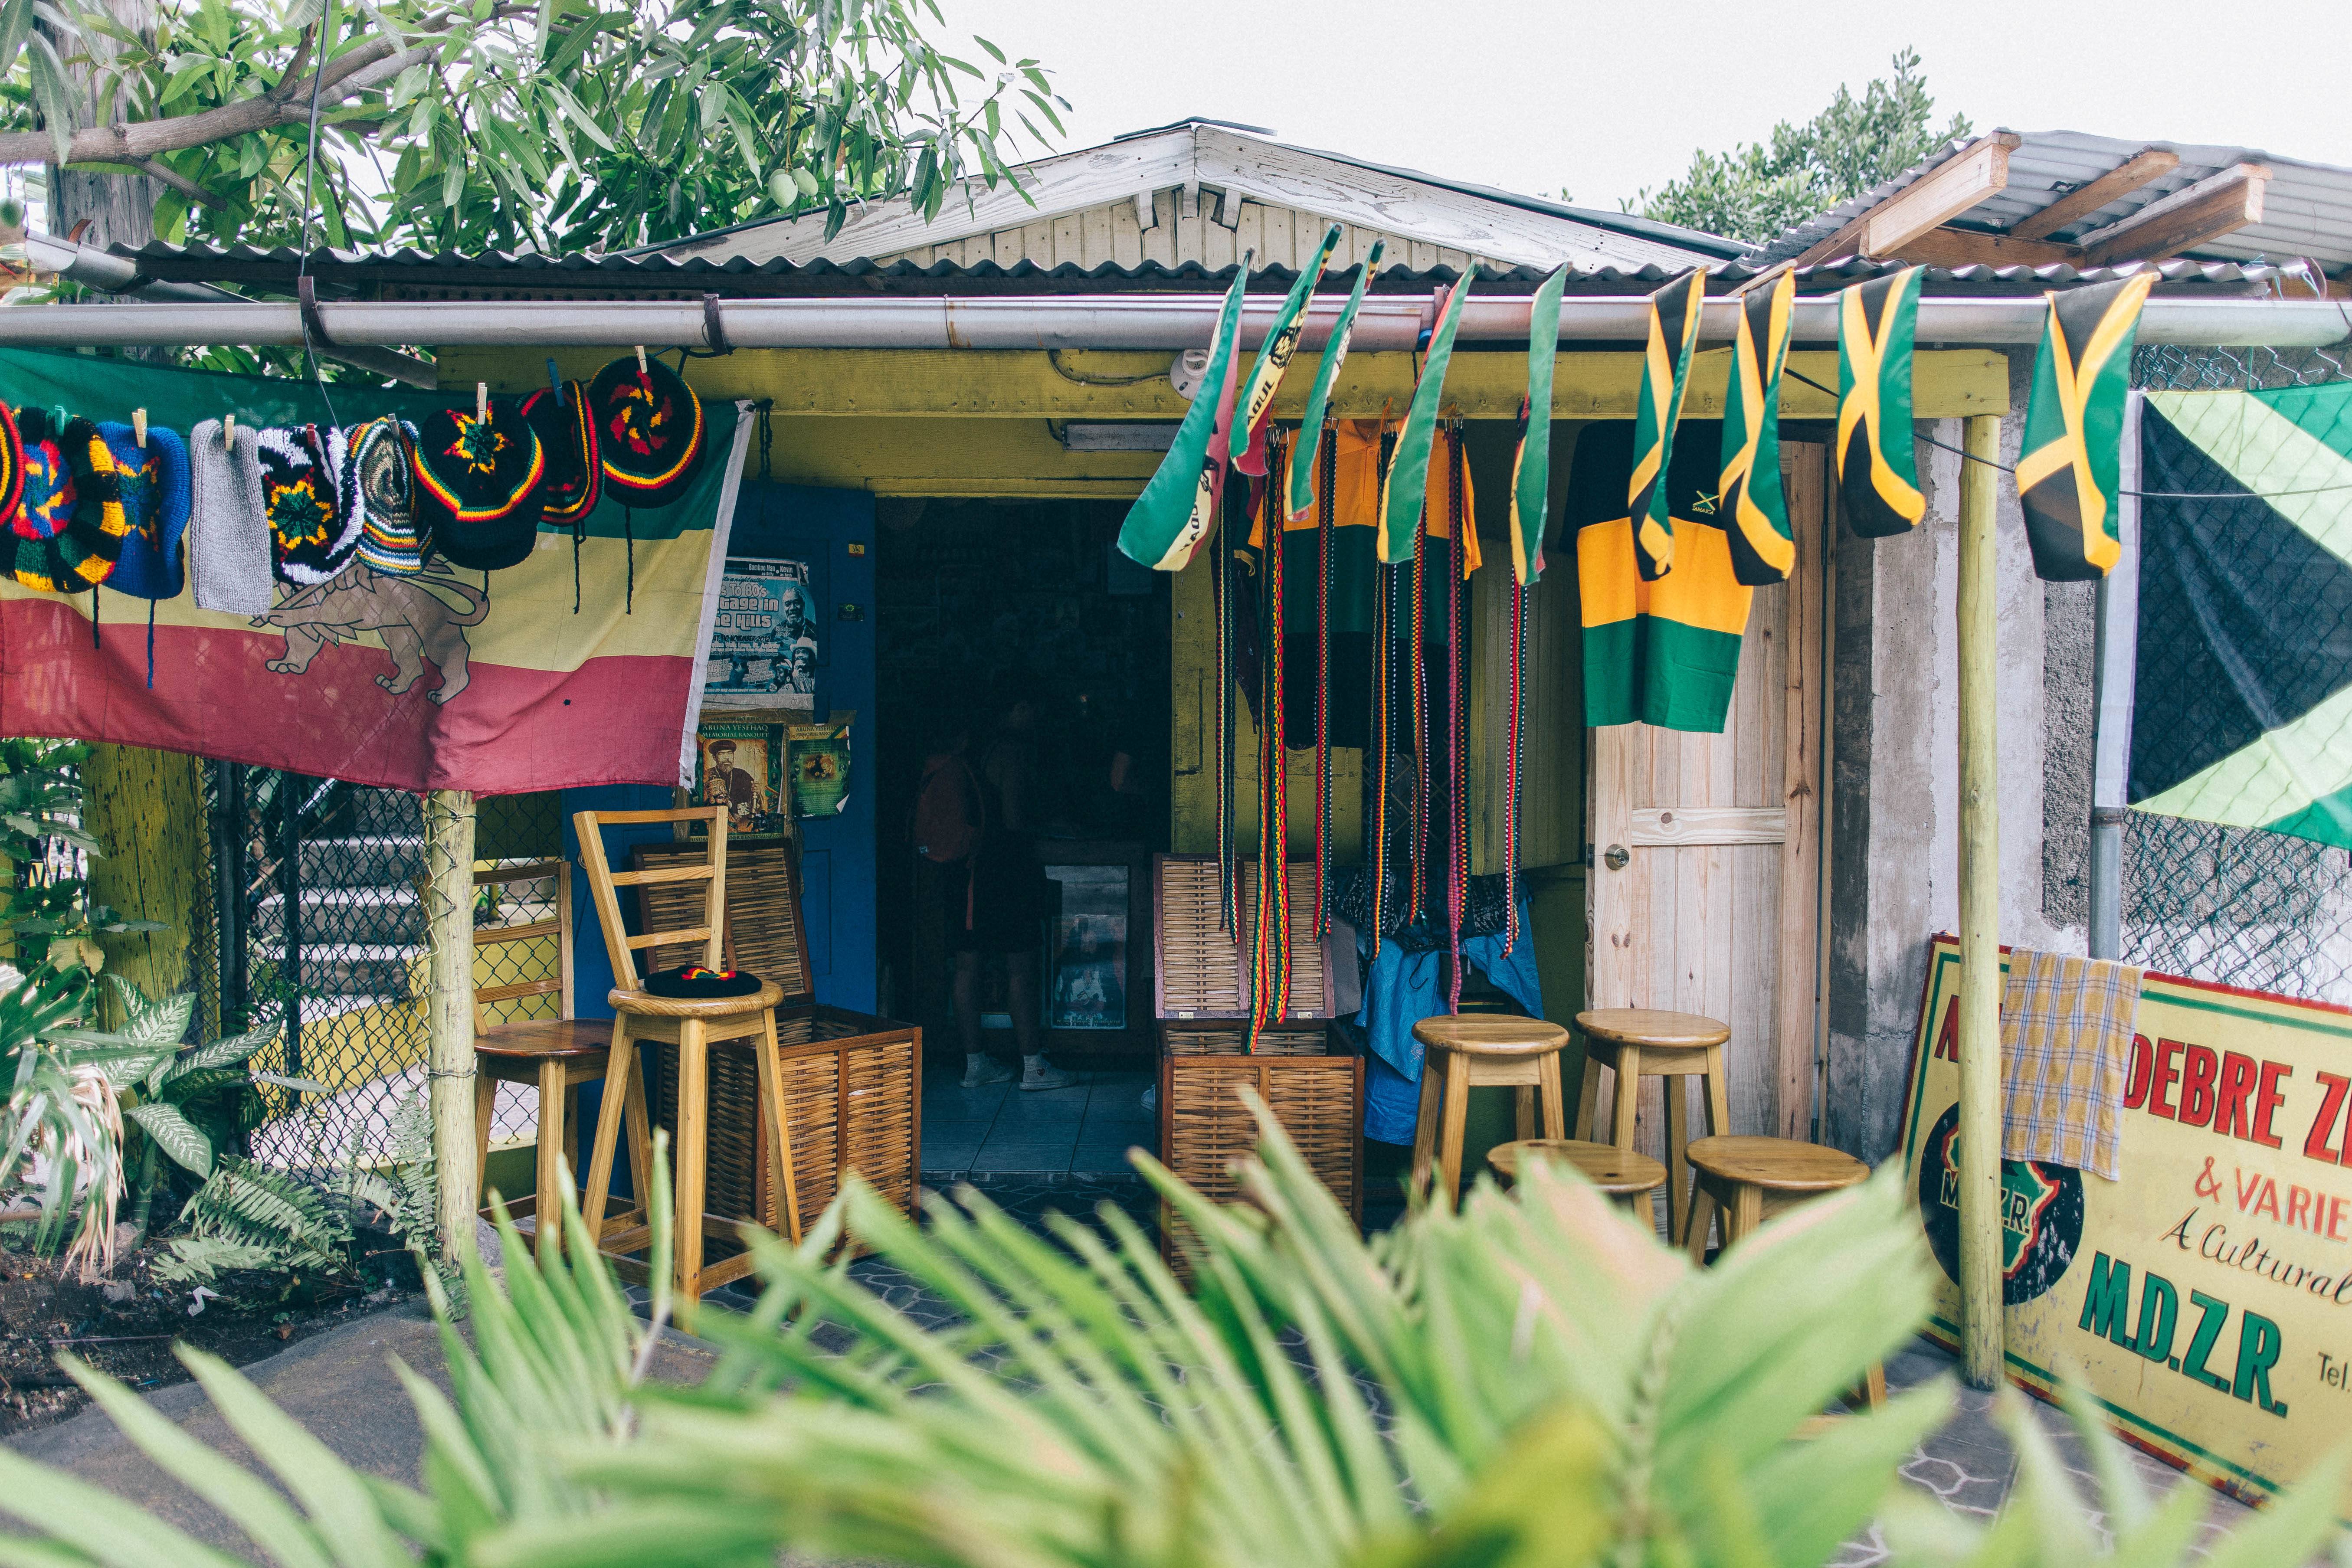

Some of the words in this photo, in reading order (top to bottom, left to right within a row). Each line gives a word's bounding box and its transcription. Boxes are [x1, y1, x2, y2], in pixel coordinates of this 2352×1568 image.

[1692, 506, 1714, 515] JAMAICA
[729, 583, 742, 597] To
[745, 583, 767, 597] 80's
[734, 576, 750, 585] night
[719, 596, 758, 611] tage
[763, 598, 779, 612] in
[736, 613, 772, 631] Hills
[2124, 1033, 2293, 1149] DEBRE
[2304, 1071, 2352, 1167] Z
[2195, 1156, 2223, 1204] &
[2158, 1206, 2191, 1251] A
[2198, 1223, 2352, 1306] Cultural
[2078, 1250, 2288, 1419] M.D.Z.R.
[2318, 1352, 2351, 1394] Tel.
